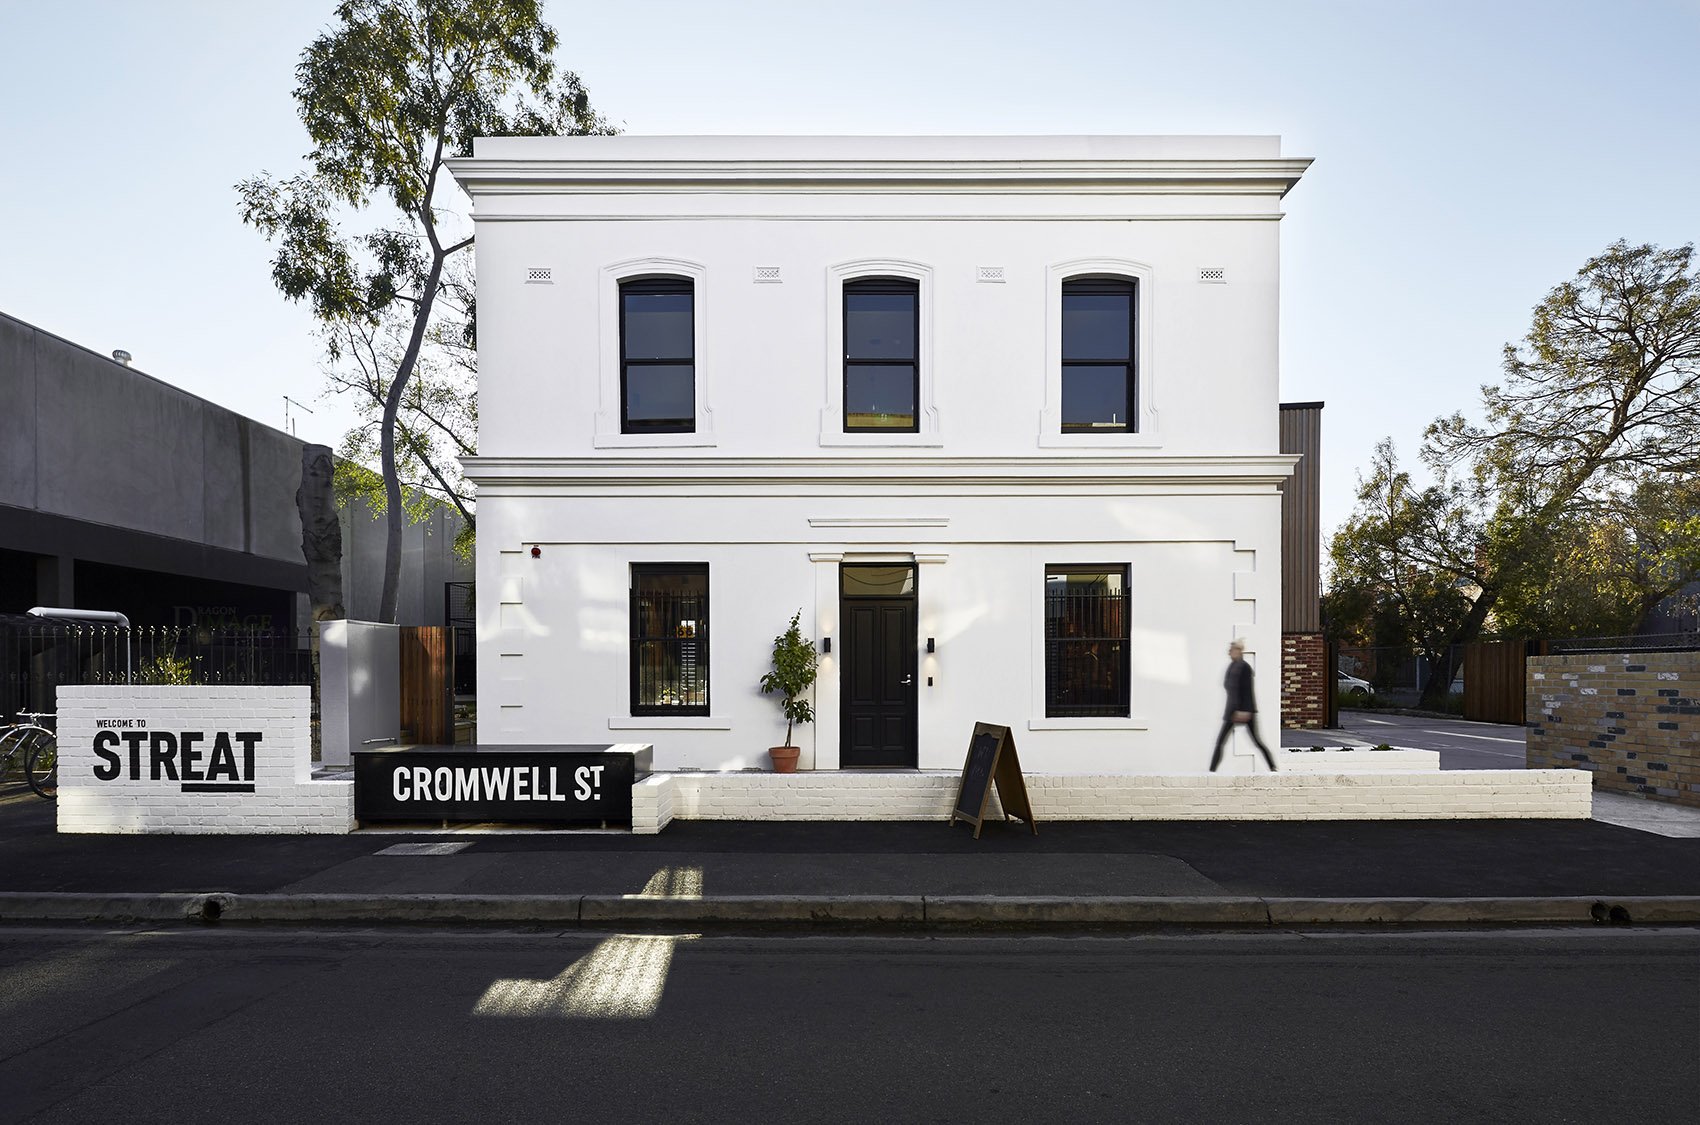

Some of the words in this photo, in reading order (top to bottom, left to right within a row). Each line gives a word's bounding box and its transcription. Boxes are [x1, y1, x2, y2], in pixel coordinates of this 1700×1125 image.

[172, 605, 237, 631] DRAGON
[199, 614, 273, 632] IMAGE
[96, 719, 133, 728] WELCOME
[136, 719, 146, 728] TO
[92, 730, 263, 782] STREAT
[393, 766, 566, 801] CROMWELL
